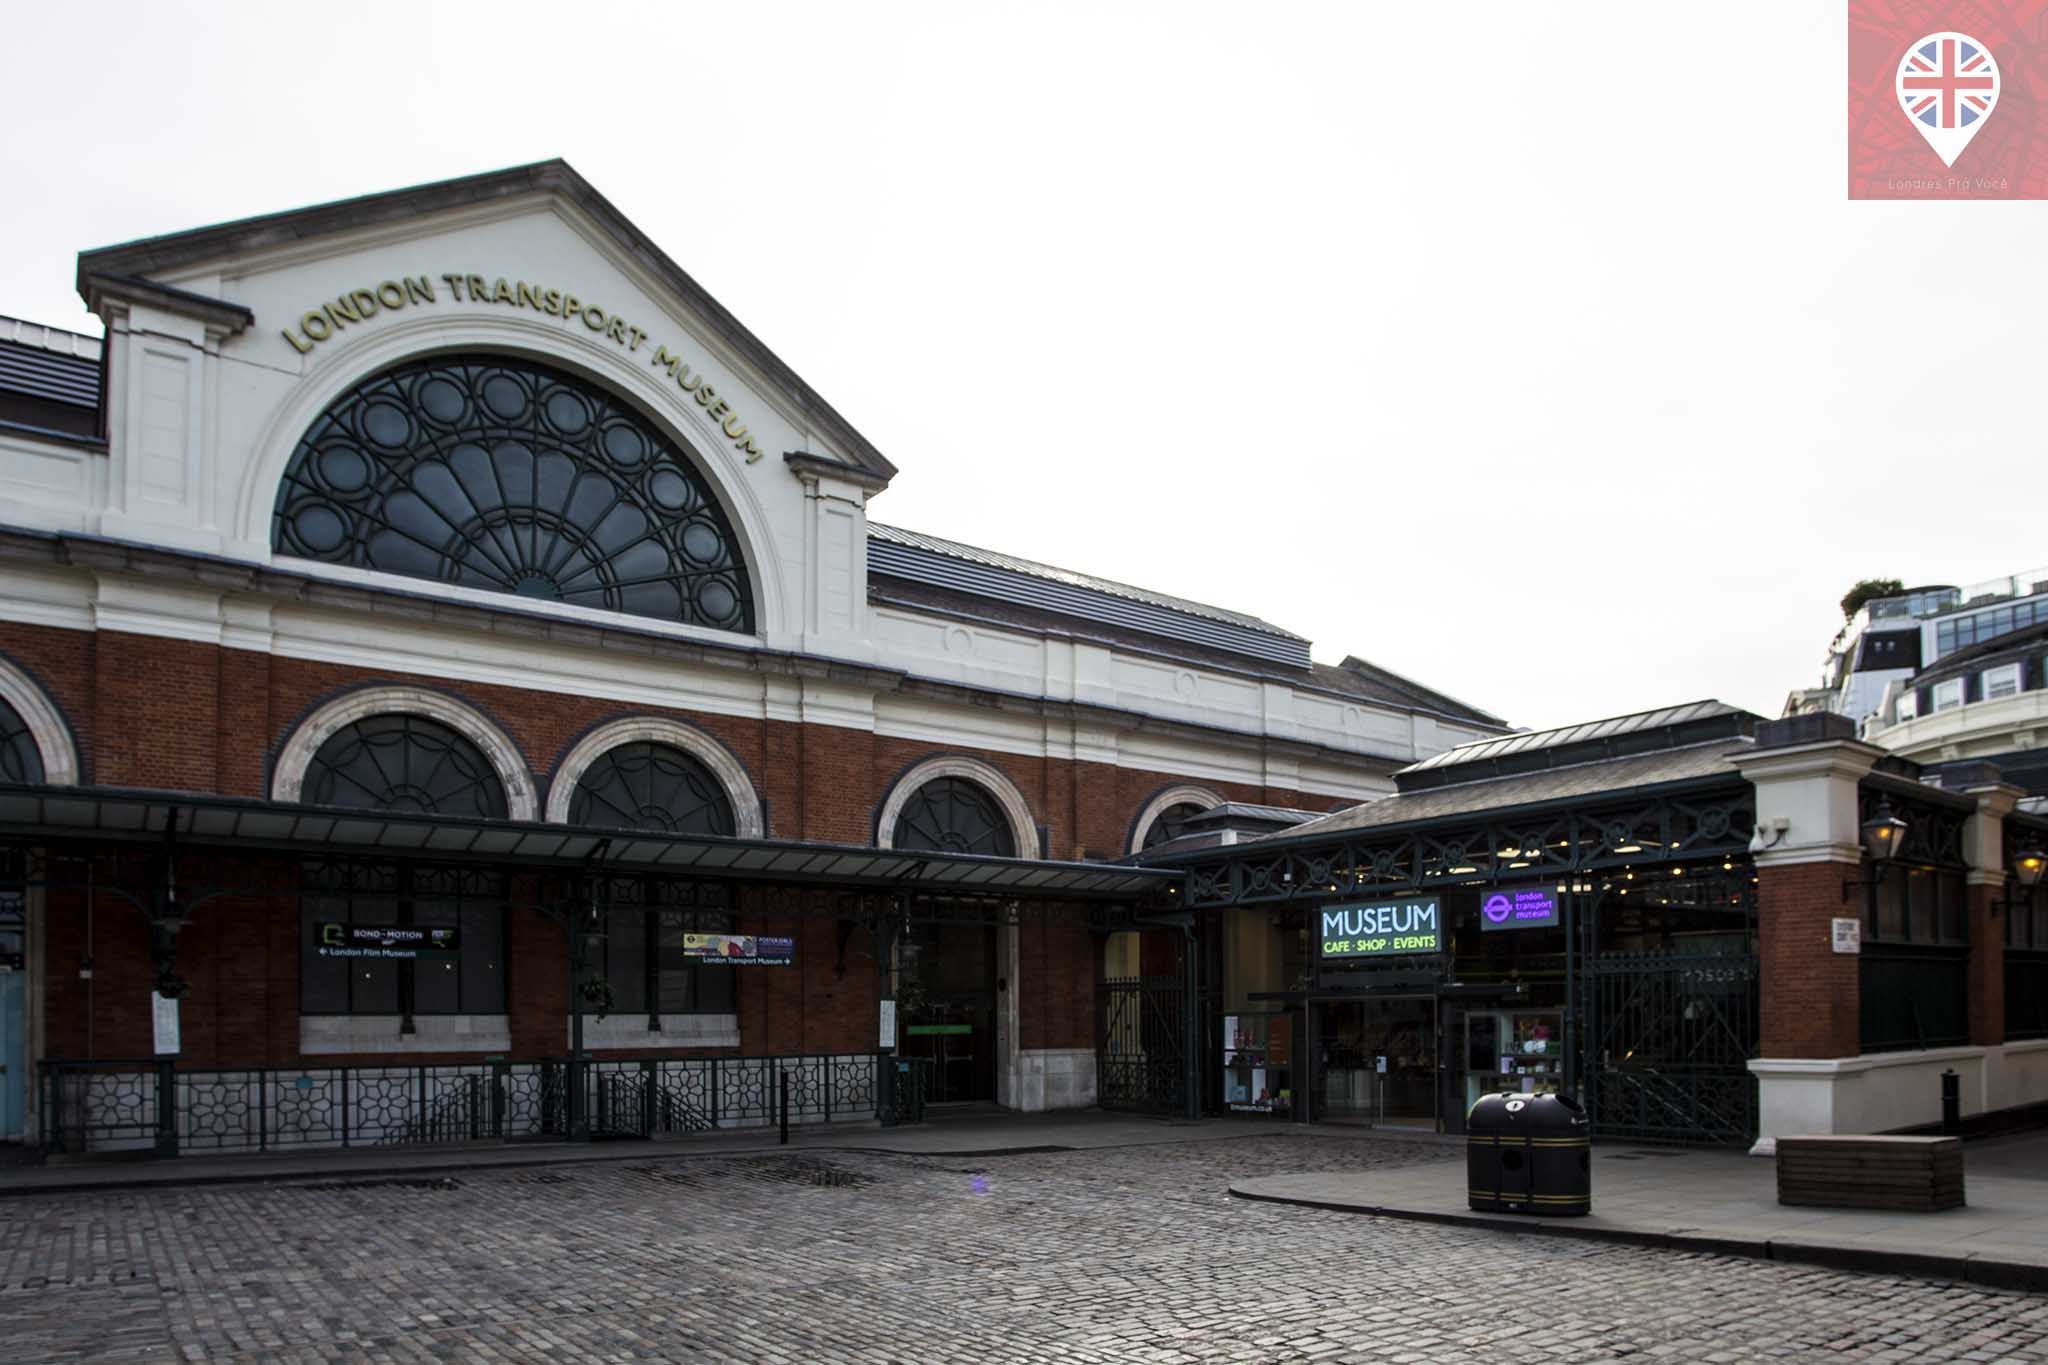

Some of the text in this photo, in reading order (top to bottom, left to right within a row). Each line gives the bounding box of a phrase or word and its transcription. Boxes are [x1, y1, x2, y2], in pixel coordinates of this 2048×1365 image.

[281, 273, 764, 465] LONDON TRANSPORT MUSEUM
[1516, 900, 1552, 910] transport
[1323, 903, 1436, 937] MUSEUM
[386, 929, 424, 940] MOTION
[1323, 935, 1436, 953] CAFE SHOP EVENTS
[329, 948, 417, 958] London Film Museum
[703, 956, 784, 966] London Transport Museum
